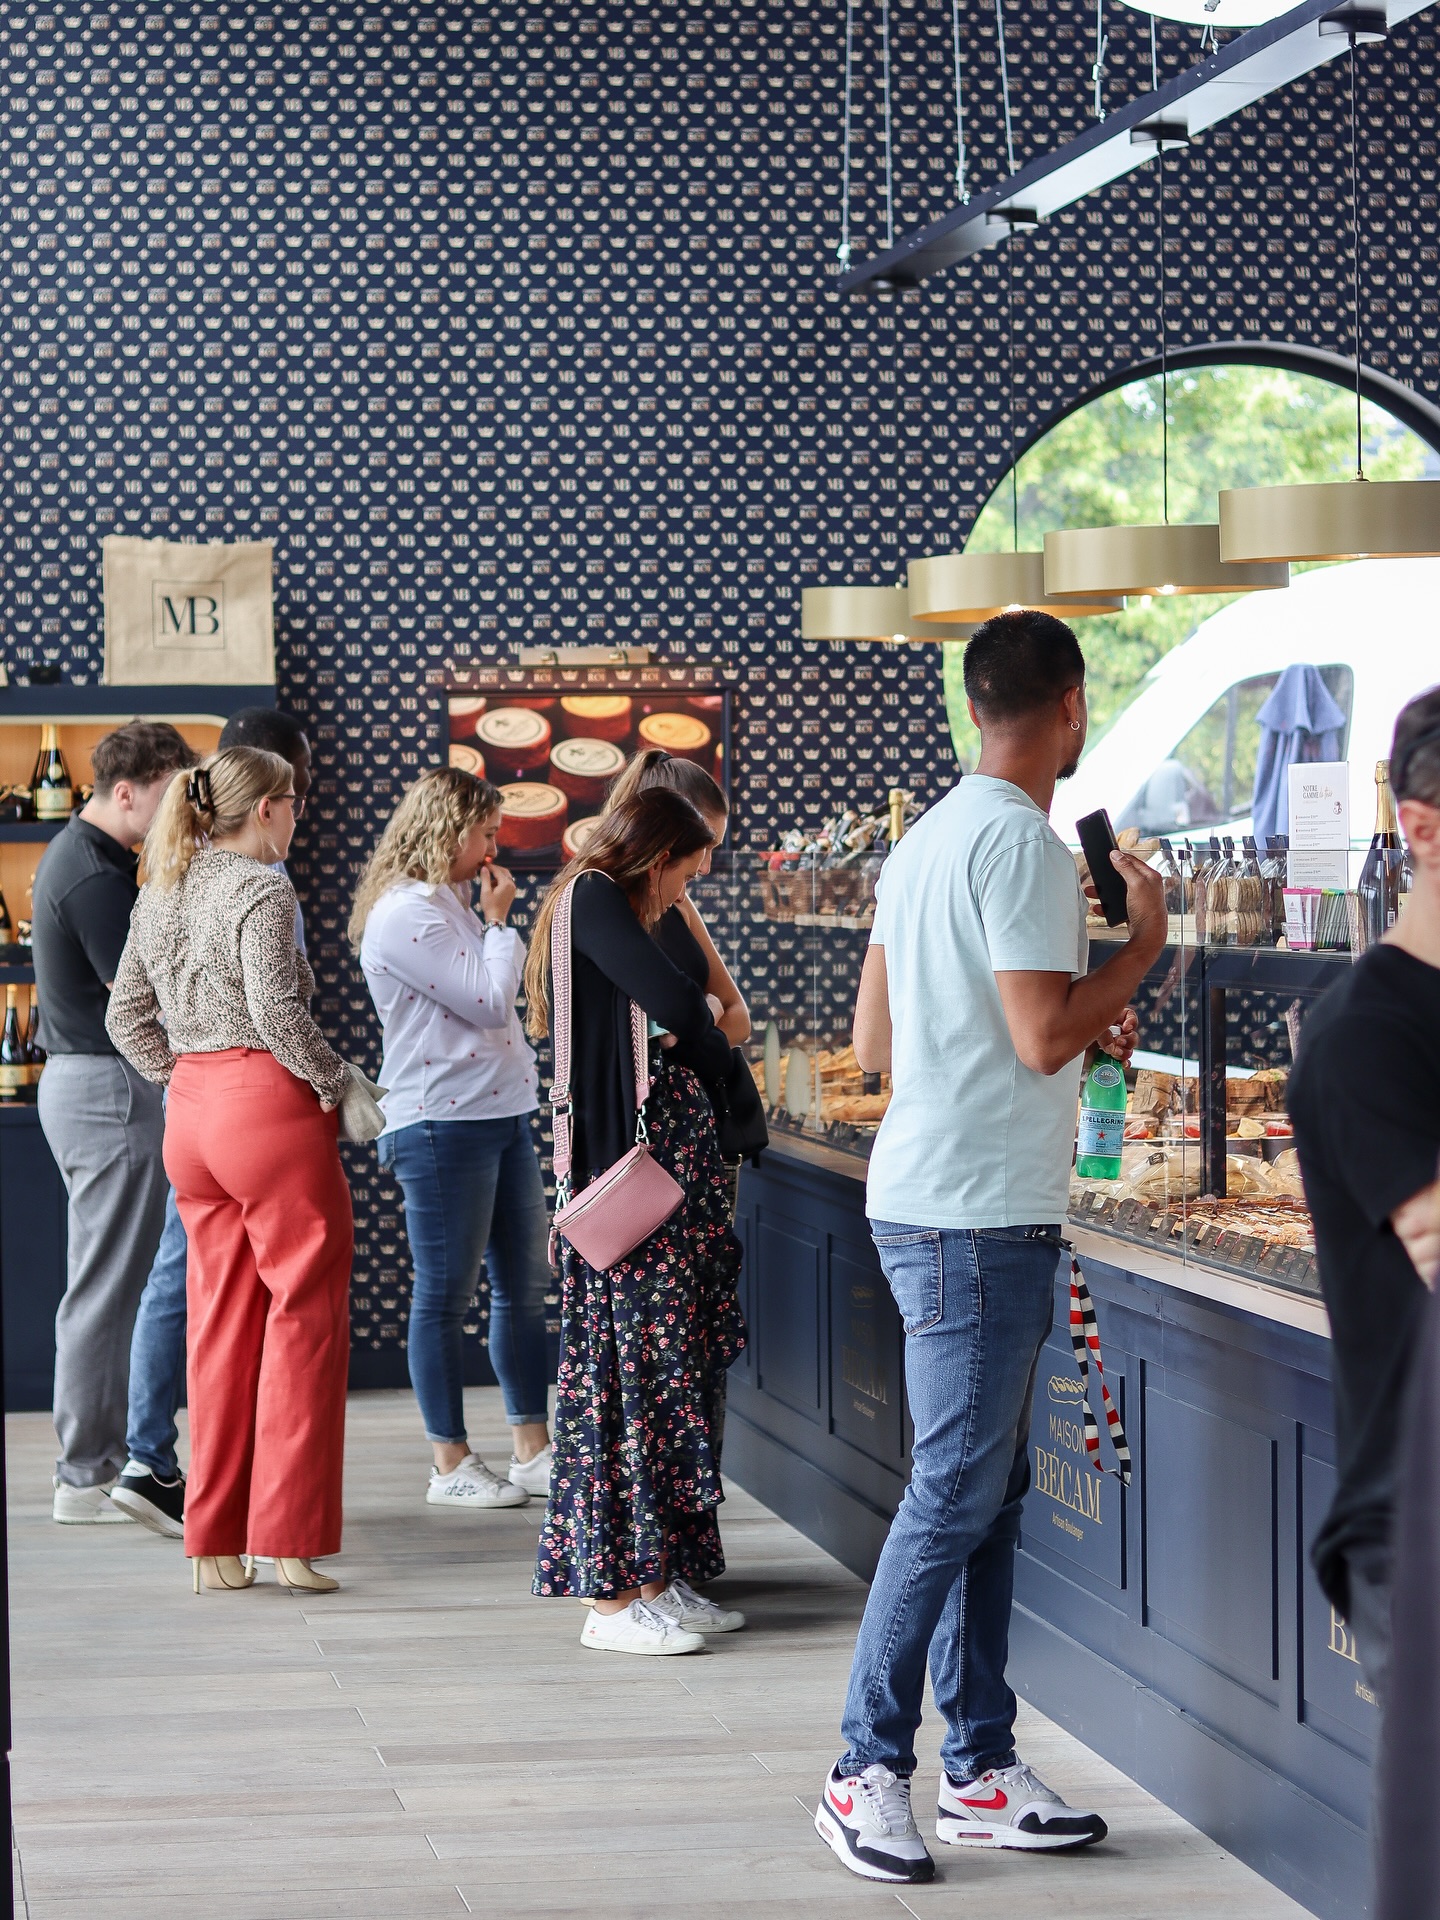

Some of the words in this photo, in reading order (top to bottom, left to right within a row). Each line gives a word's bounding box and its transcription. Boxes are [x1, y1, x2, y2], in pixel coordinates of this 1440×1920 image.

[160, 595, 220, 636] MB
[1303, 784, 1318, 792] NOTRE
[512, 913, 529, 925] MB
[1049, 1413, 1086, 1456] MAISON
[1034, 1446, 1103, 1525] BÉCAM
